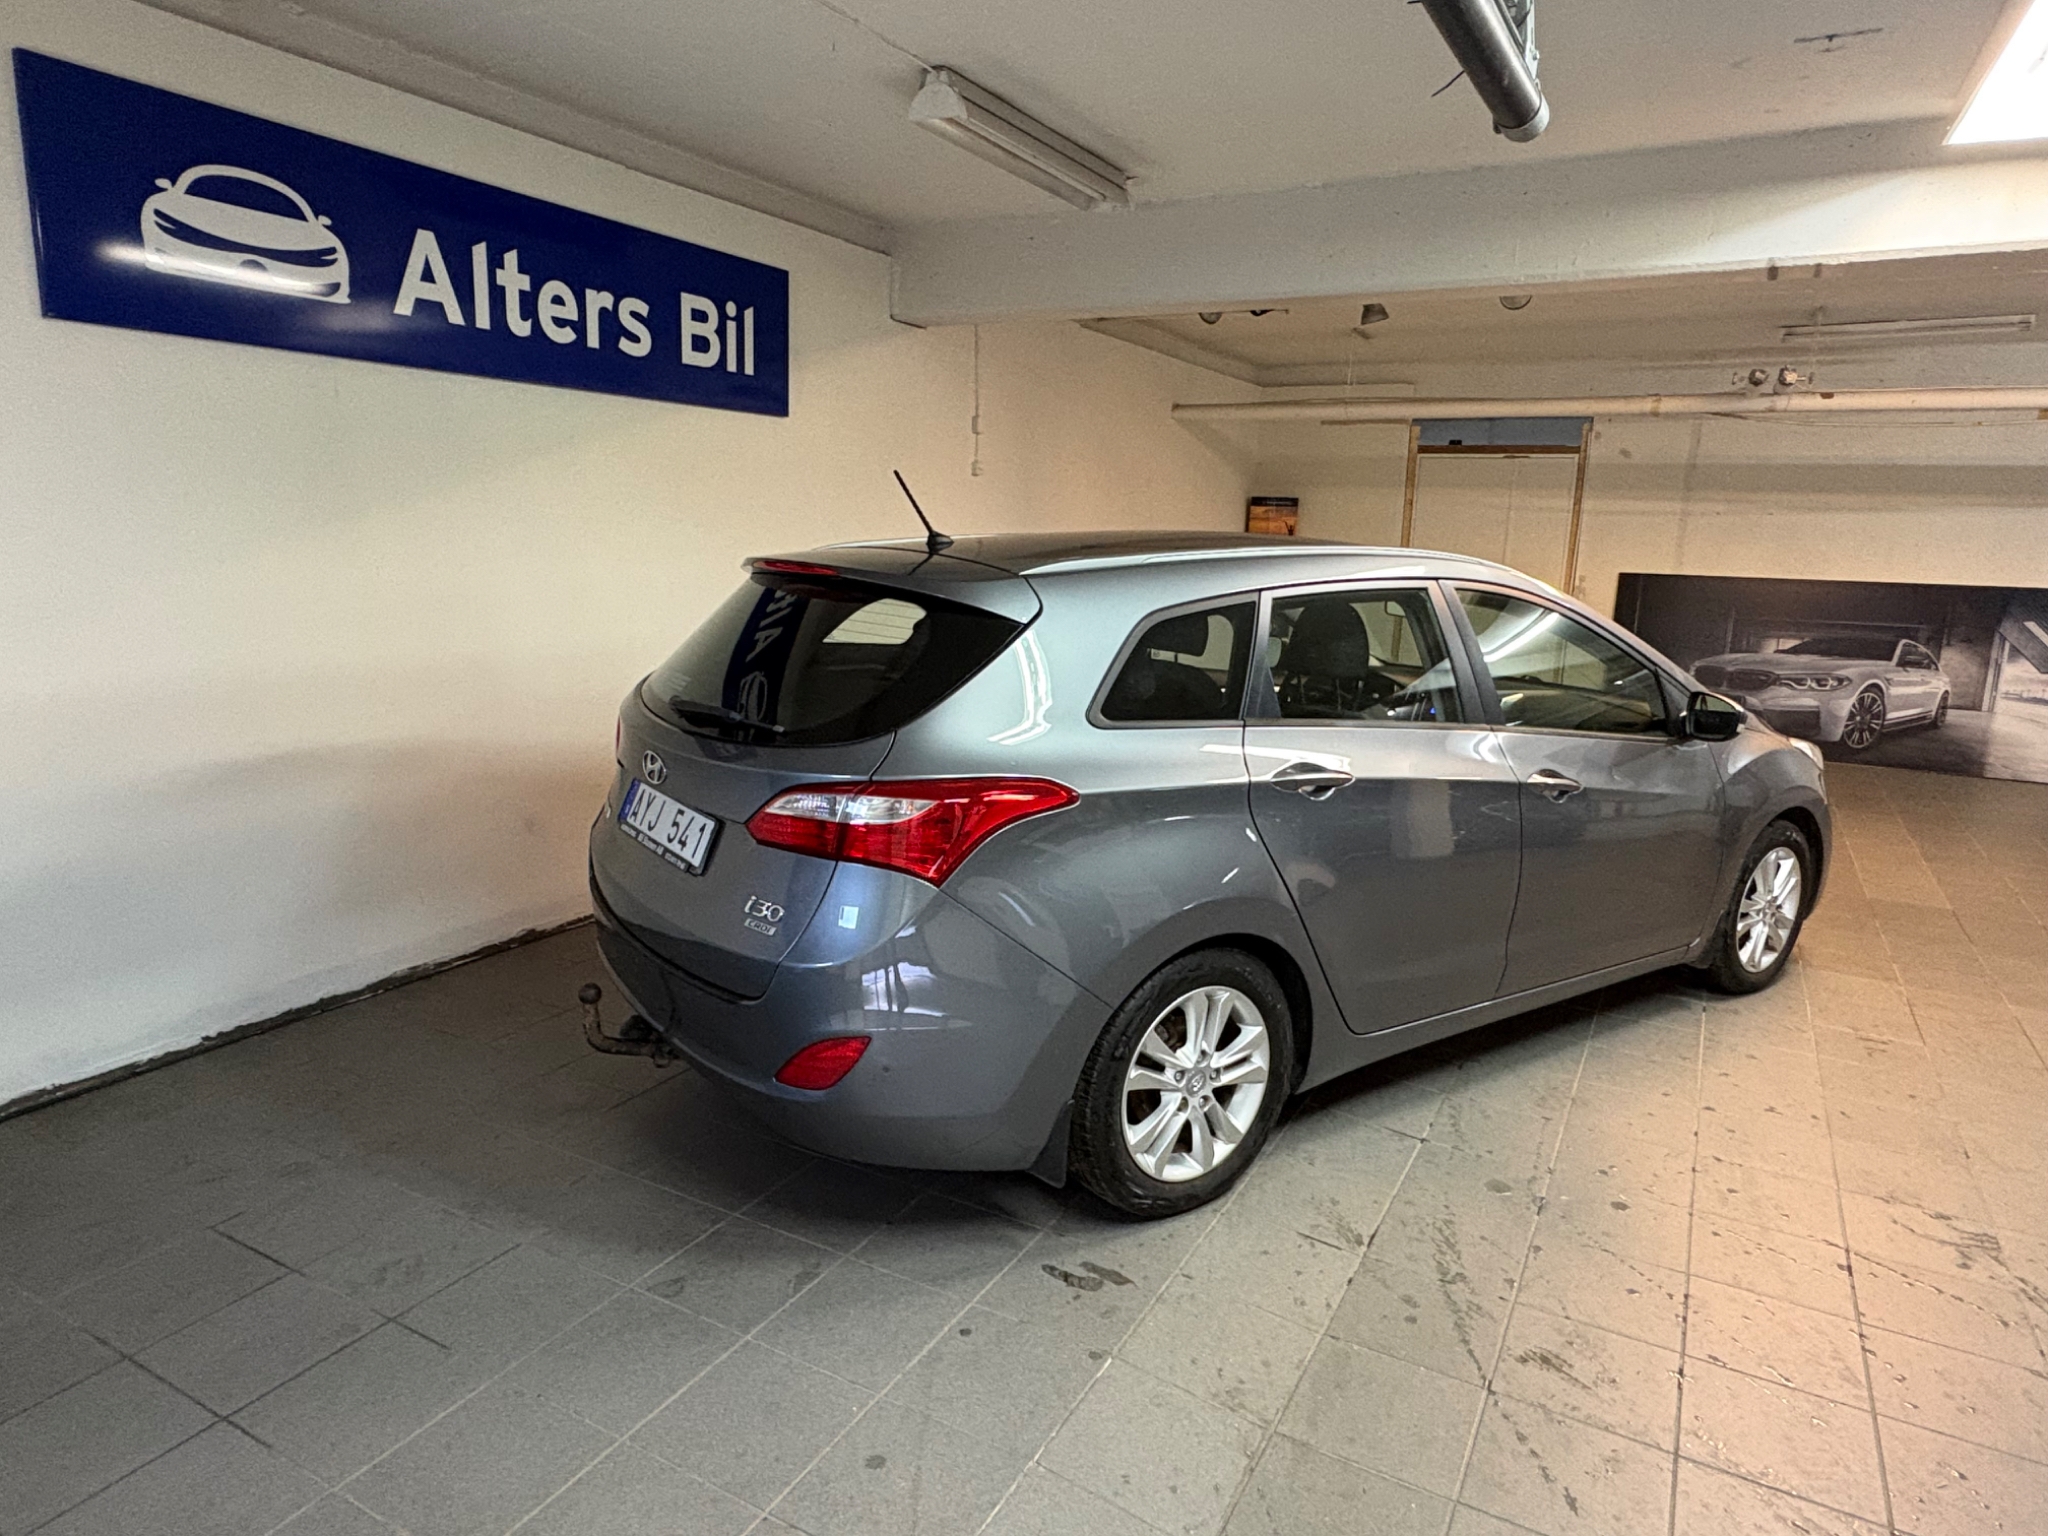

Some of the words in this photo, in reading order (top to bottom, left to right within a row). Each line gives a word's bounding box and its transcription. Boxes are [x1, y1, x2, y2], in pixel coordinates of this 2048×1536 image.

[393, 228, 652, 358] Alters
[680, 292, 755, 377] Bil
[629, 788, 667, 832] AYJ
[667, 808, 707, 860] 541
[744, 895, 786, 923] i30
